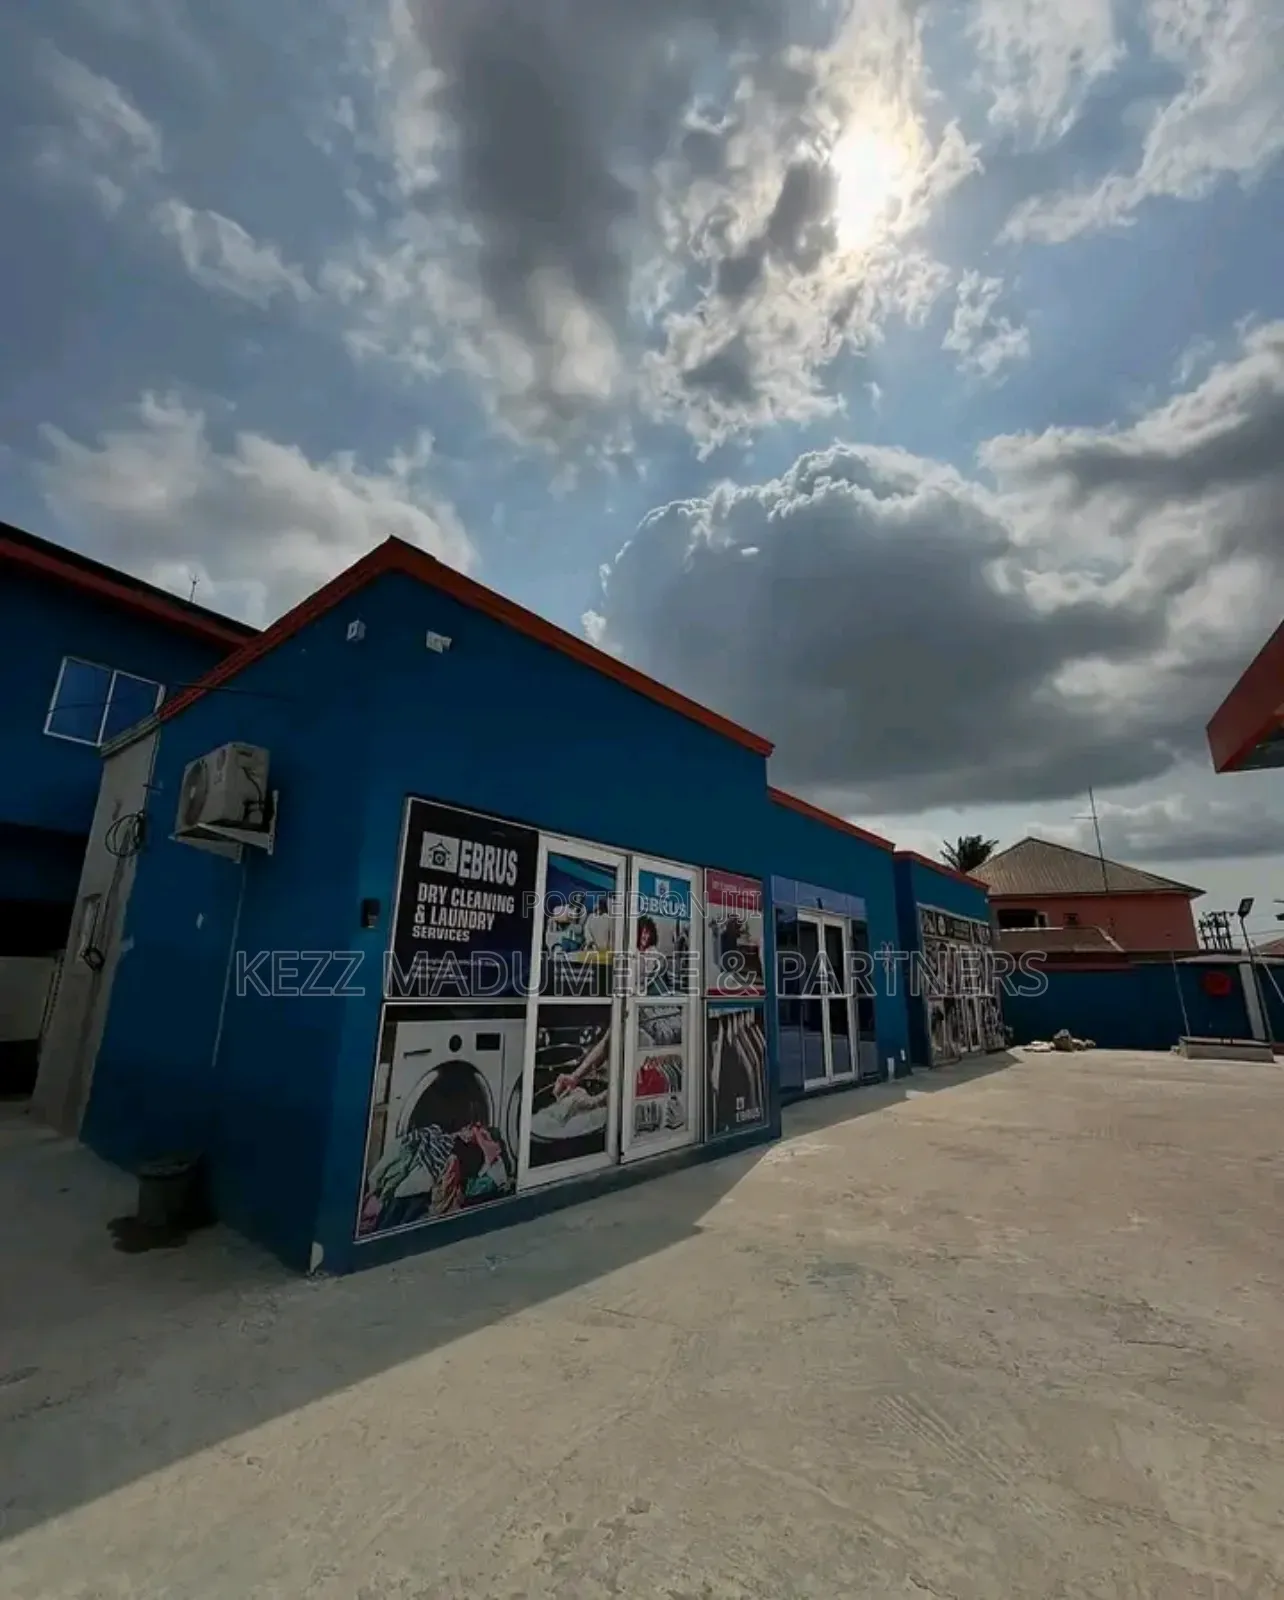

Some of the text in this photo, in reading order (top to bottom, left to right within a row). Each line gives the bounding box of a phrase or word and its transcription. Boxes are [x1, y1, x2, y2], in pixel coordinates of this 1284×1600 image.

[458, 839, 519, 887] EBRUS
[417, 882, 515, 914] DRY CLEANING
[414, 903, 495, 931] & LAUNDRY
[411, 925, 470, 942] SERVICES
